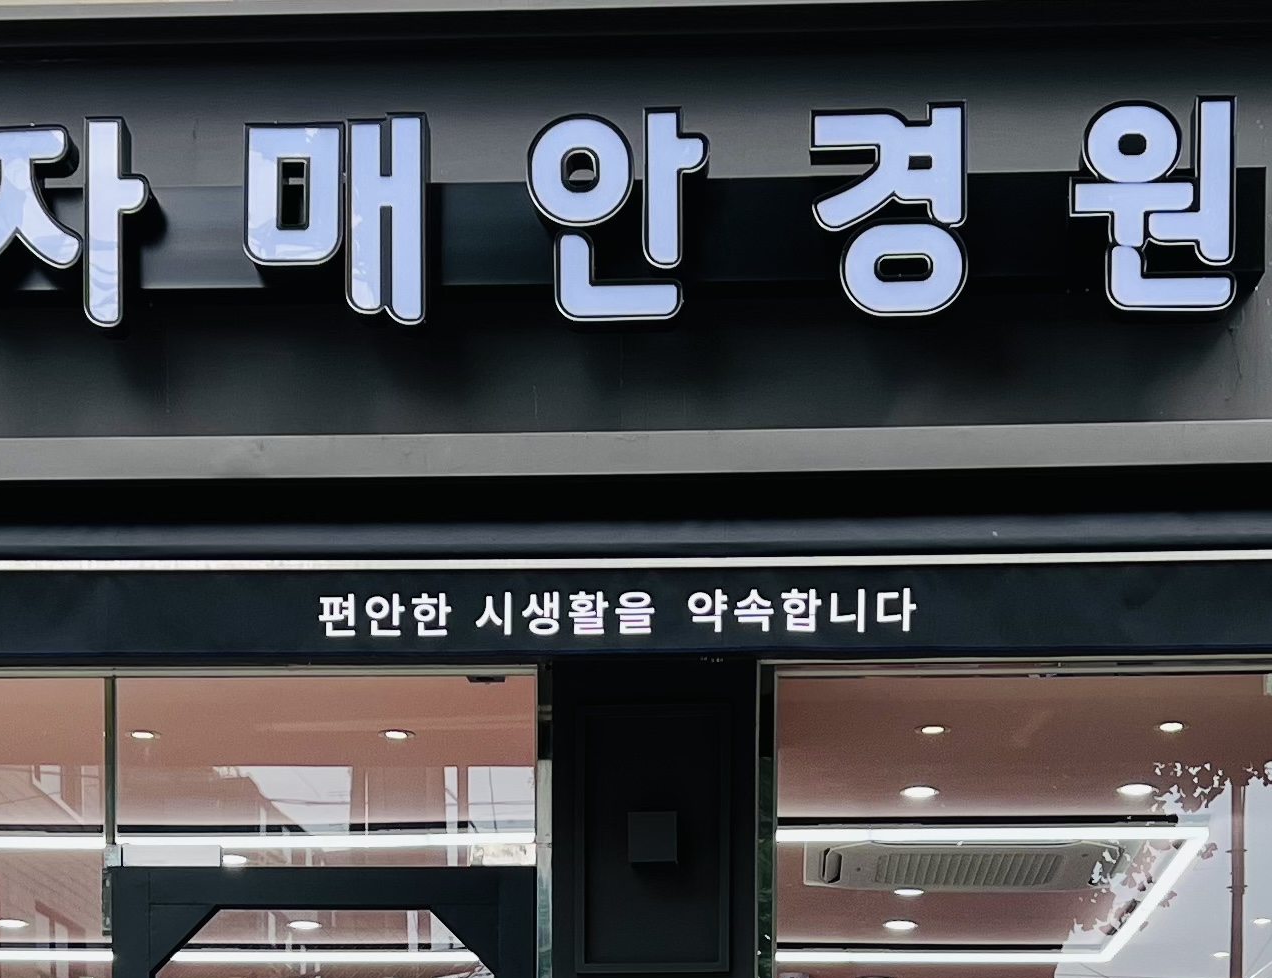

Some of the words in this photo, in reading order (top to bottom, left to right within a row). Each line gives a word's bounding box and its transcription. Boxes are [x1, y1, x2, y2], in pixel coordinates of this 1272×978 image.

[317, 592, 453, 639] 편안한
[475, 590, 657, 636] 시생활을
[687, 587, 917, 634] 약속합니다
